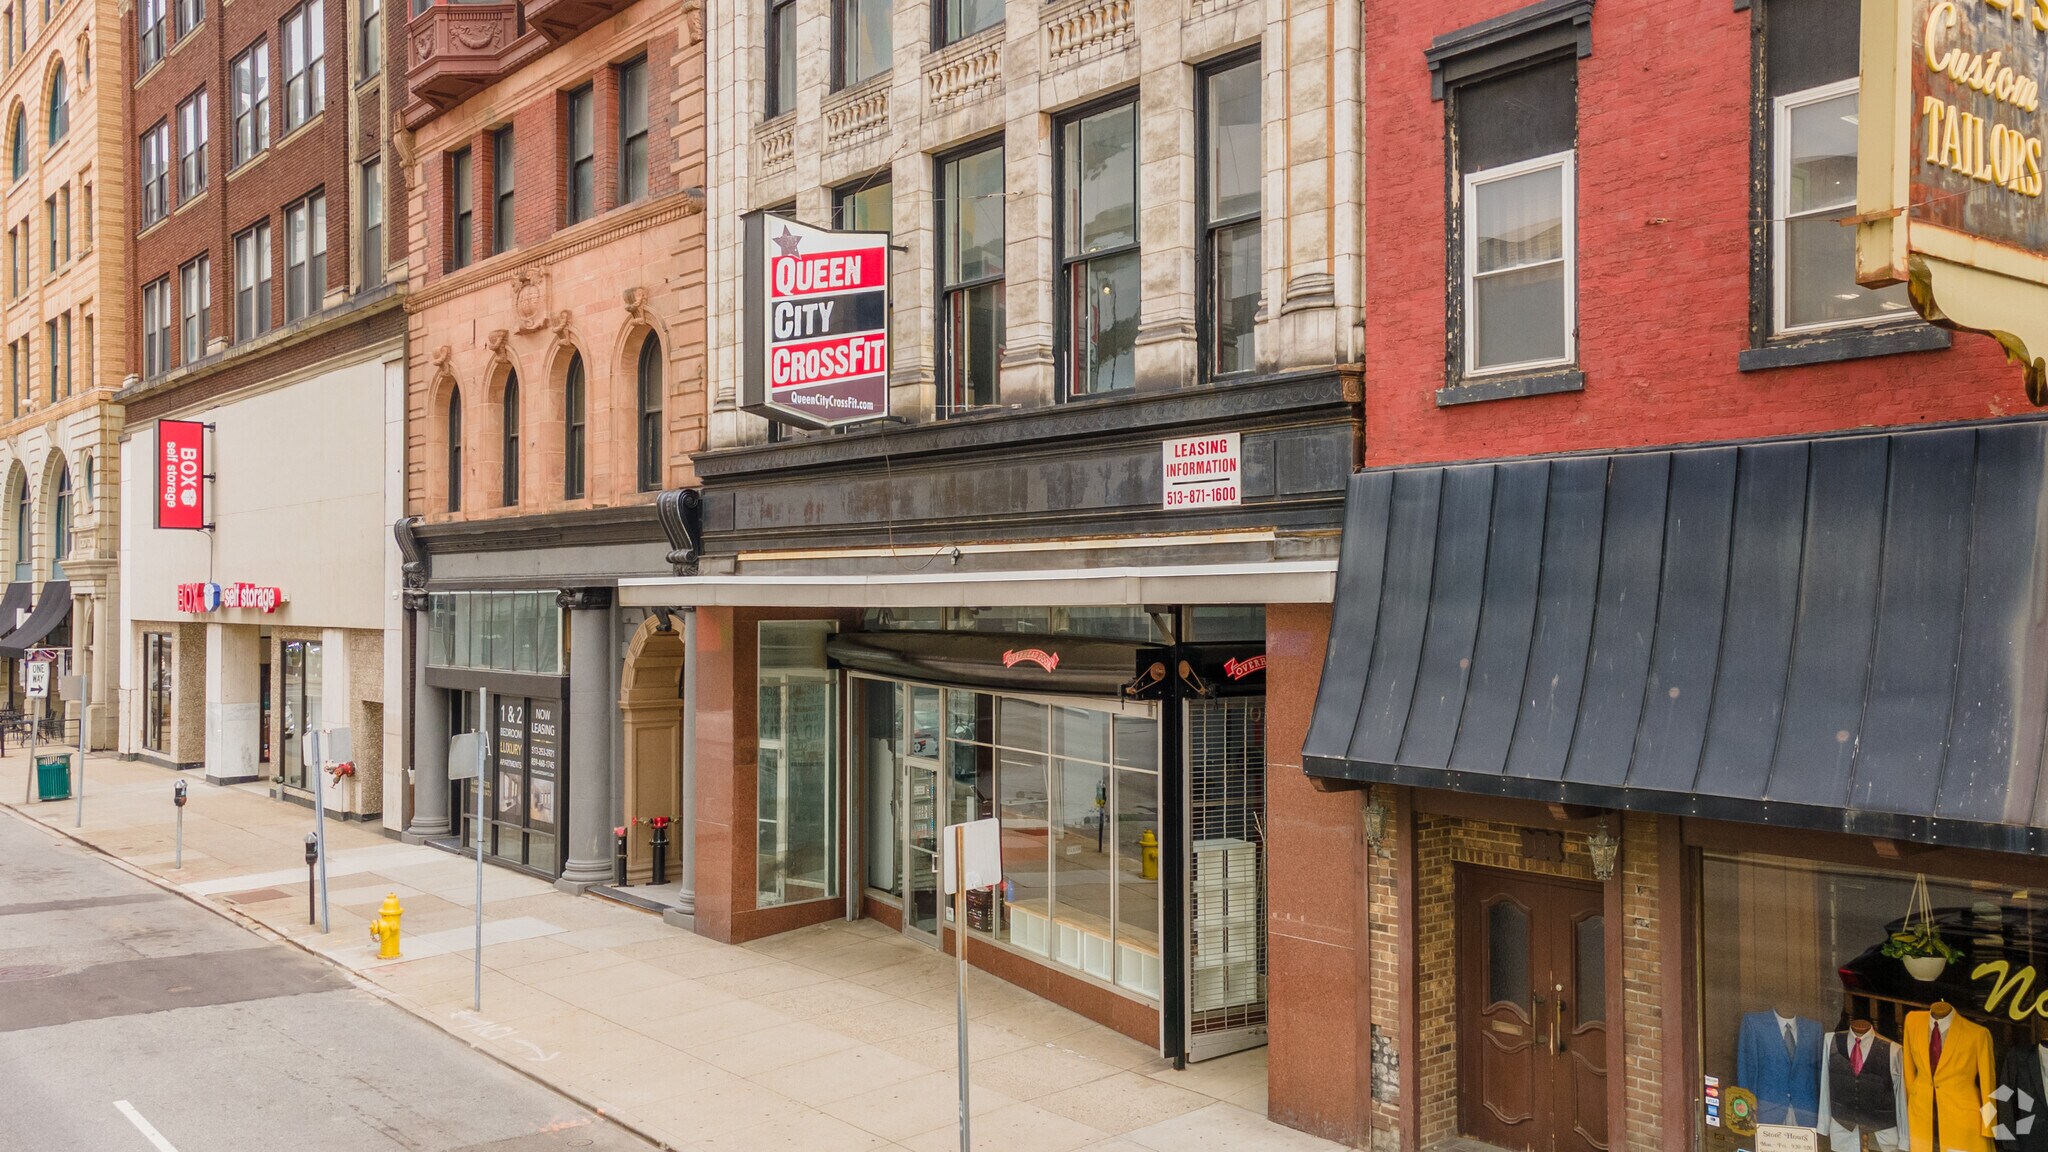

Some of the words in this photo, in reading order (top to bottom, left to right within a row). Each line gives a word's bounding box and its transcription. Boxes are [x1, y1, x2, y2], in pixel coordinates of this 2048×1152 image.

[1924, 2, 2039, 113] Custom
[1922, 96, 2043, 197] TAILORS
[775, 255, 862, 296] QUEEN
[774, 300, 835, 339] CITY
[791, 391, 874, 411] QueenCityCrossFit.com
[166, 441, 177, 463] self
[1174, 439, 1227, 457] LEASING
[180, 447, 198, 488] BOX
[1166, 458, 1236, 477] INFORMATION
[164, 465, 177, 509] storage
[1167, 486, 1236, 505] 513-871-1600
[178, 583, 202, 613] BOX
[224, 583, 241, 608] self
[240, 585, 275, 613] storage
[33, 664, 45, 674] ONE
[33, 675, 45, 683] WAY
[501, 704, 505, 722] 1
[507, 705, 515, 724] &
[516, 706, 523, 724] 2
[535, 708, 551, 721] NOW
[500, 727, 523, 739] BEDROOM
[531, 722, 555, 736] LEASING
[500, 741, 523, 756] LUXURY
[1762, 1130, 1782, 1138] Store
[1784, 1132, 1809, 1142] Hours
